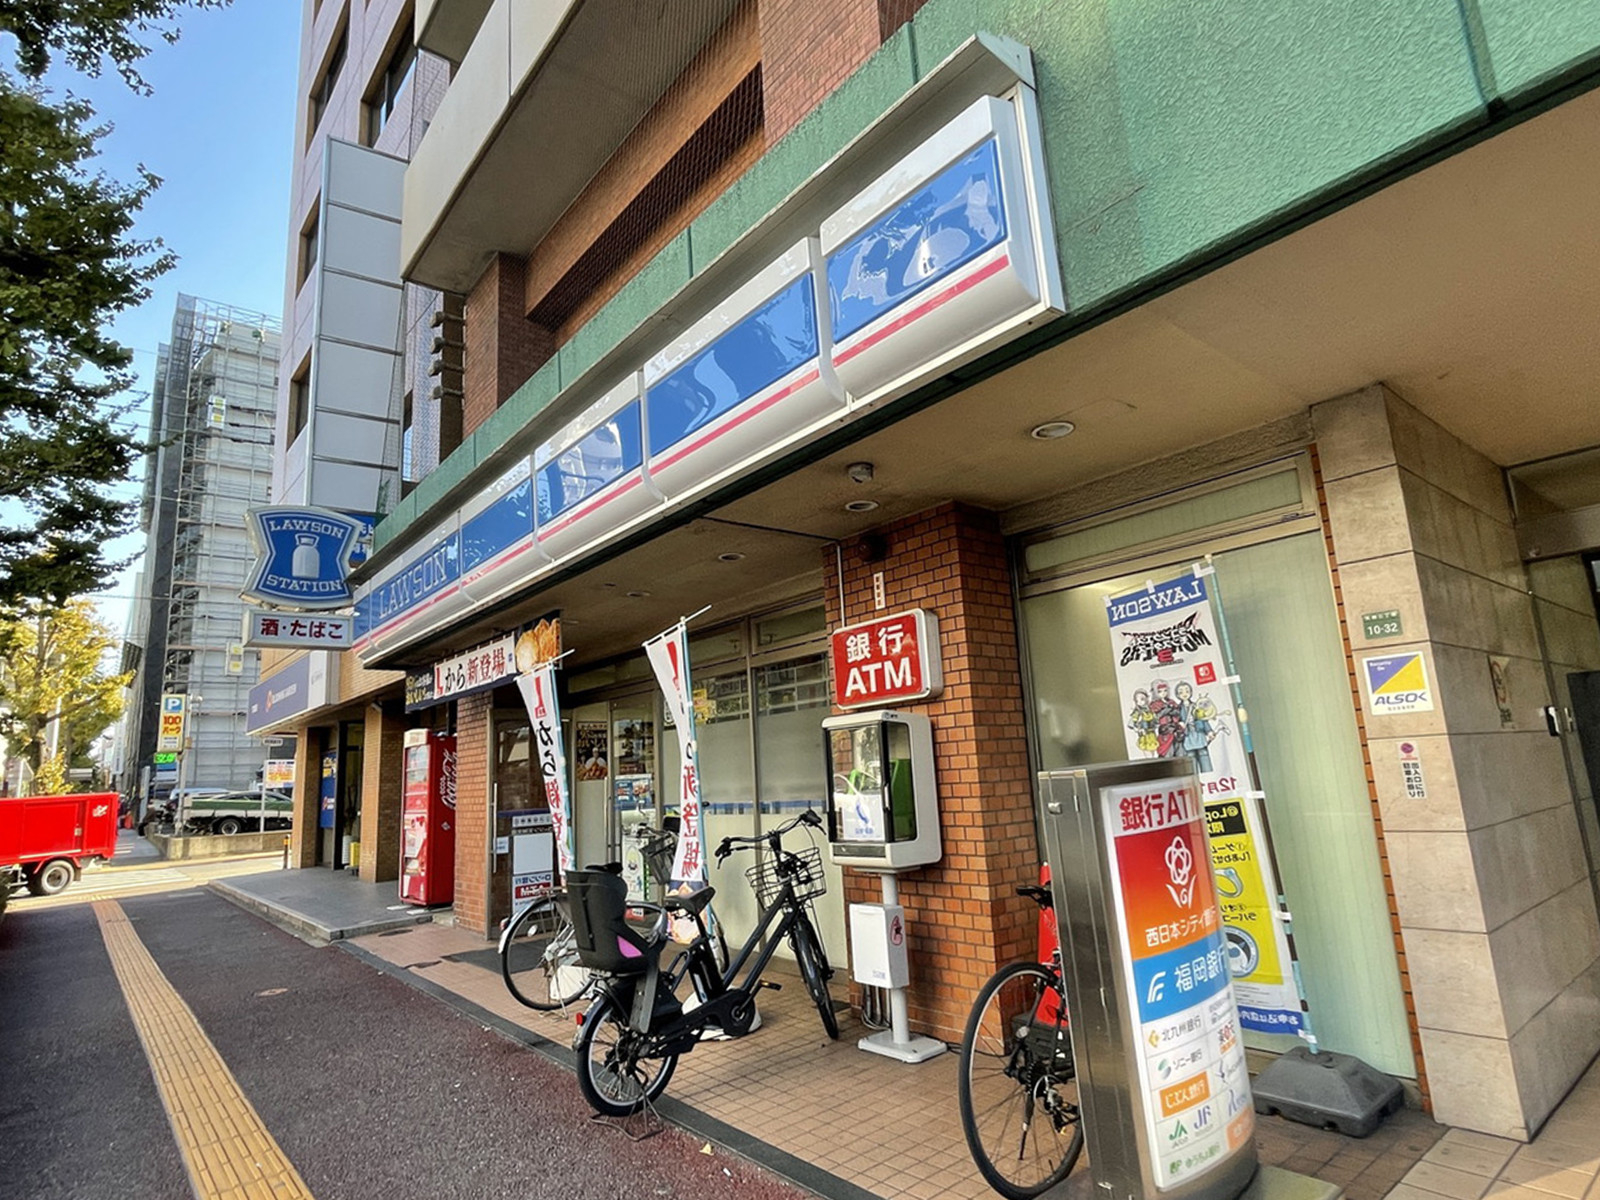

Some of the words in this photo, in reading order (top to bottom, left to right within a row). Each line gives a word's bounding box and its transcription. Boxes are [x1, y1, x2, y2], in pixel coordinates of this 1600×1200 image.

[268, 519, 345, 539] LAWSON
[266, 574, 343, 592] STATION
[379, 546, 448, 619] LAWSON
[260, 618, 343, 639] 酒・たばこ
[1367, 622, 1399, 635] 10-32
[846, 624, 904, 663] 銀行
[845, 657, 912, 697] ATM
[167, 698, 181, 711] P
[1374, 692, 1427, 706] ALSOK
[163, 715, 182, 725] 100
[162, 726, 182, 735] パーク
[1162, 1015, 1201, 1041] 北九州銀行
